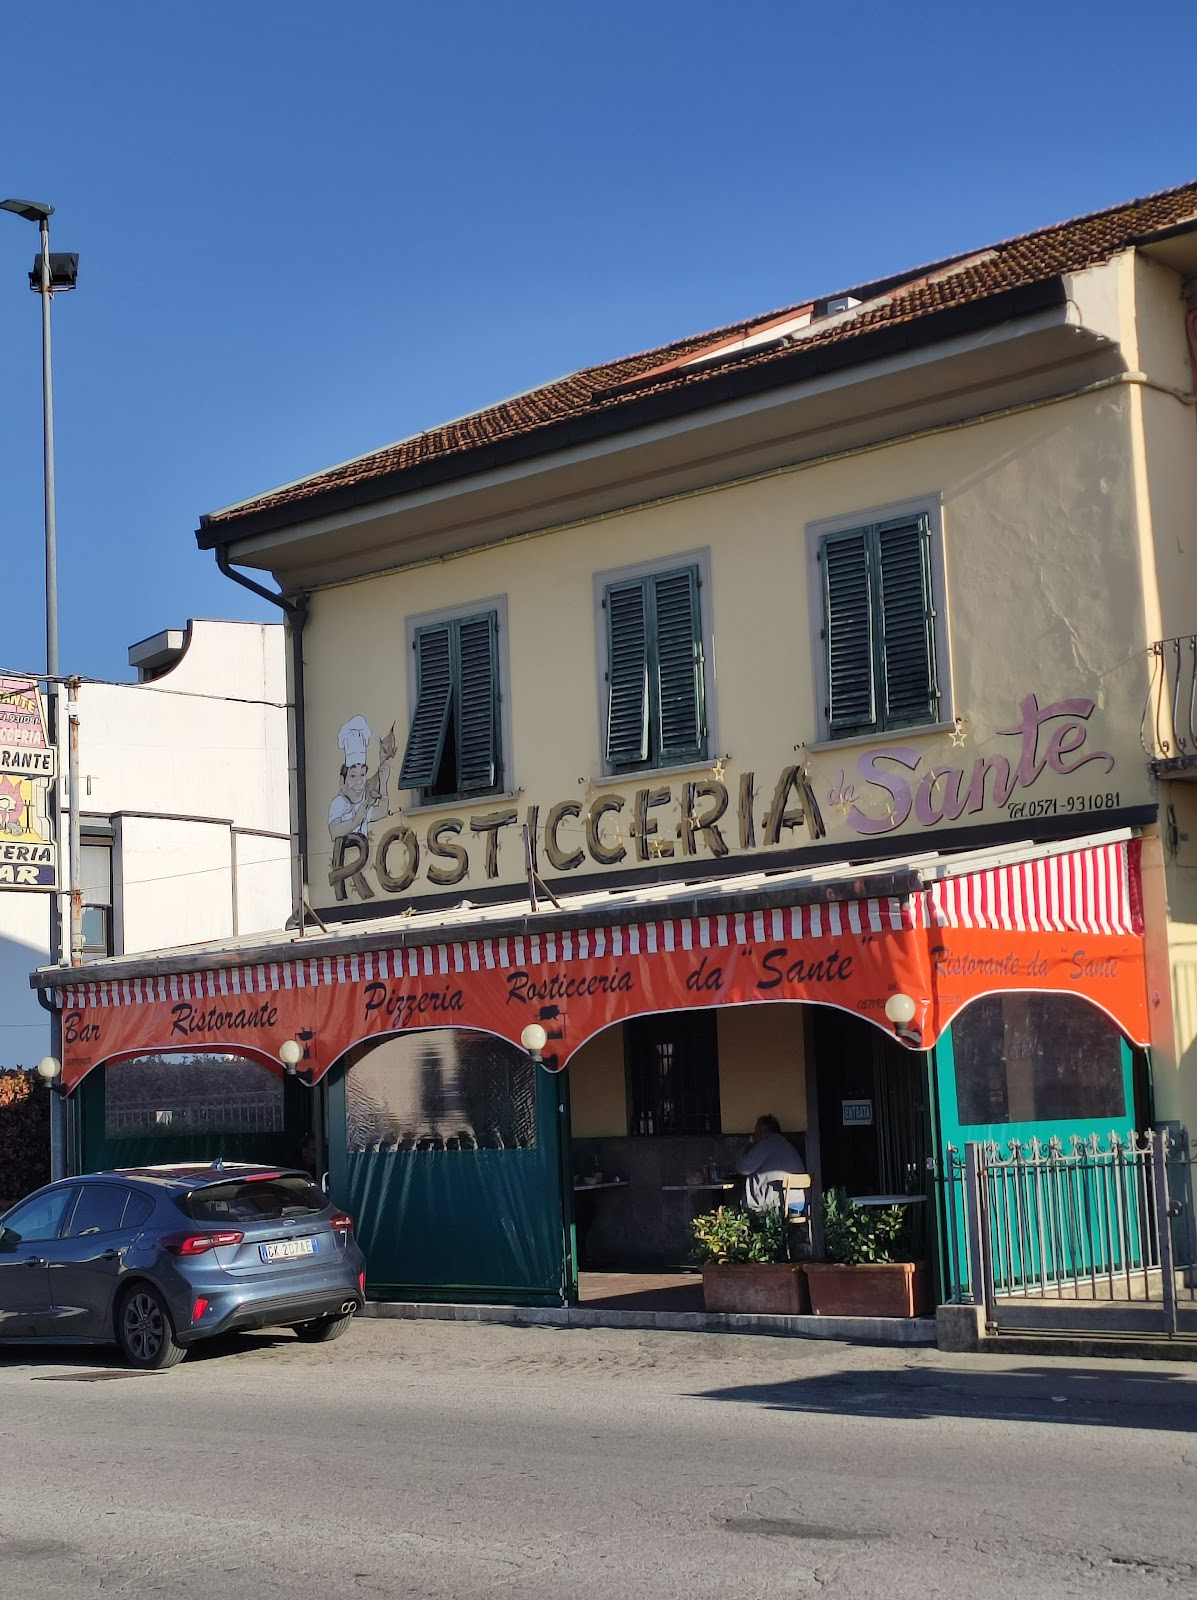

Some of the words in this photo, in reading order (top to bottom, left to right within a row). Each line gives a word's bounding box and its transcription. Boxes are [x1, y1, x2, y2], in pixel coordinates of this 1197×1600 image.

[1, 750, 51, 770] RANTE
[328, 766, 827, 902] ROSTICCERIA
[848, 693, 1115, 836] Sante
[0, 845, 51, 862] ERIA
[687, 957, 724, 991] da
[931, 946, 1020, 977] Ristorante
[1027, 951, 1048, 977] da
[506, 967, 633, 1005] Rosticceria
[171, 1002, 279, 1036] Ristorante
[364, 982, 465, 1028] Pizzeria
[65, 1012, 100, 1044] Bar
[845, 1106, 869, 1119] ENTRATA
